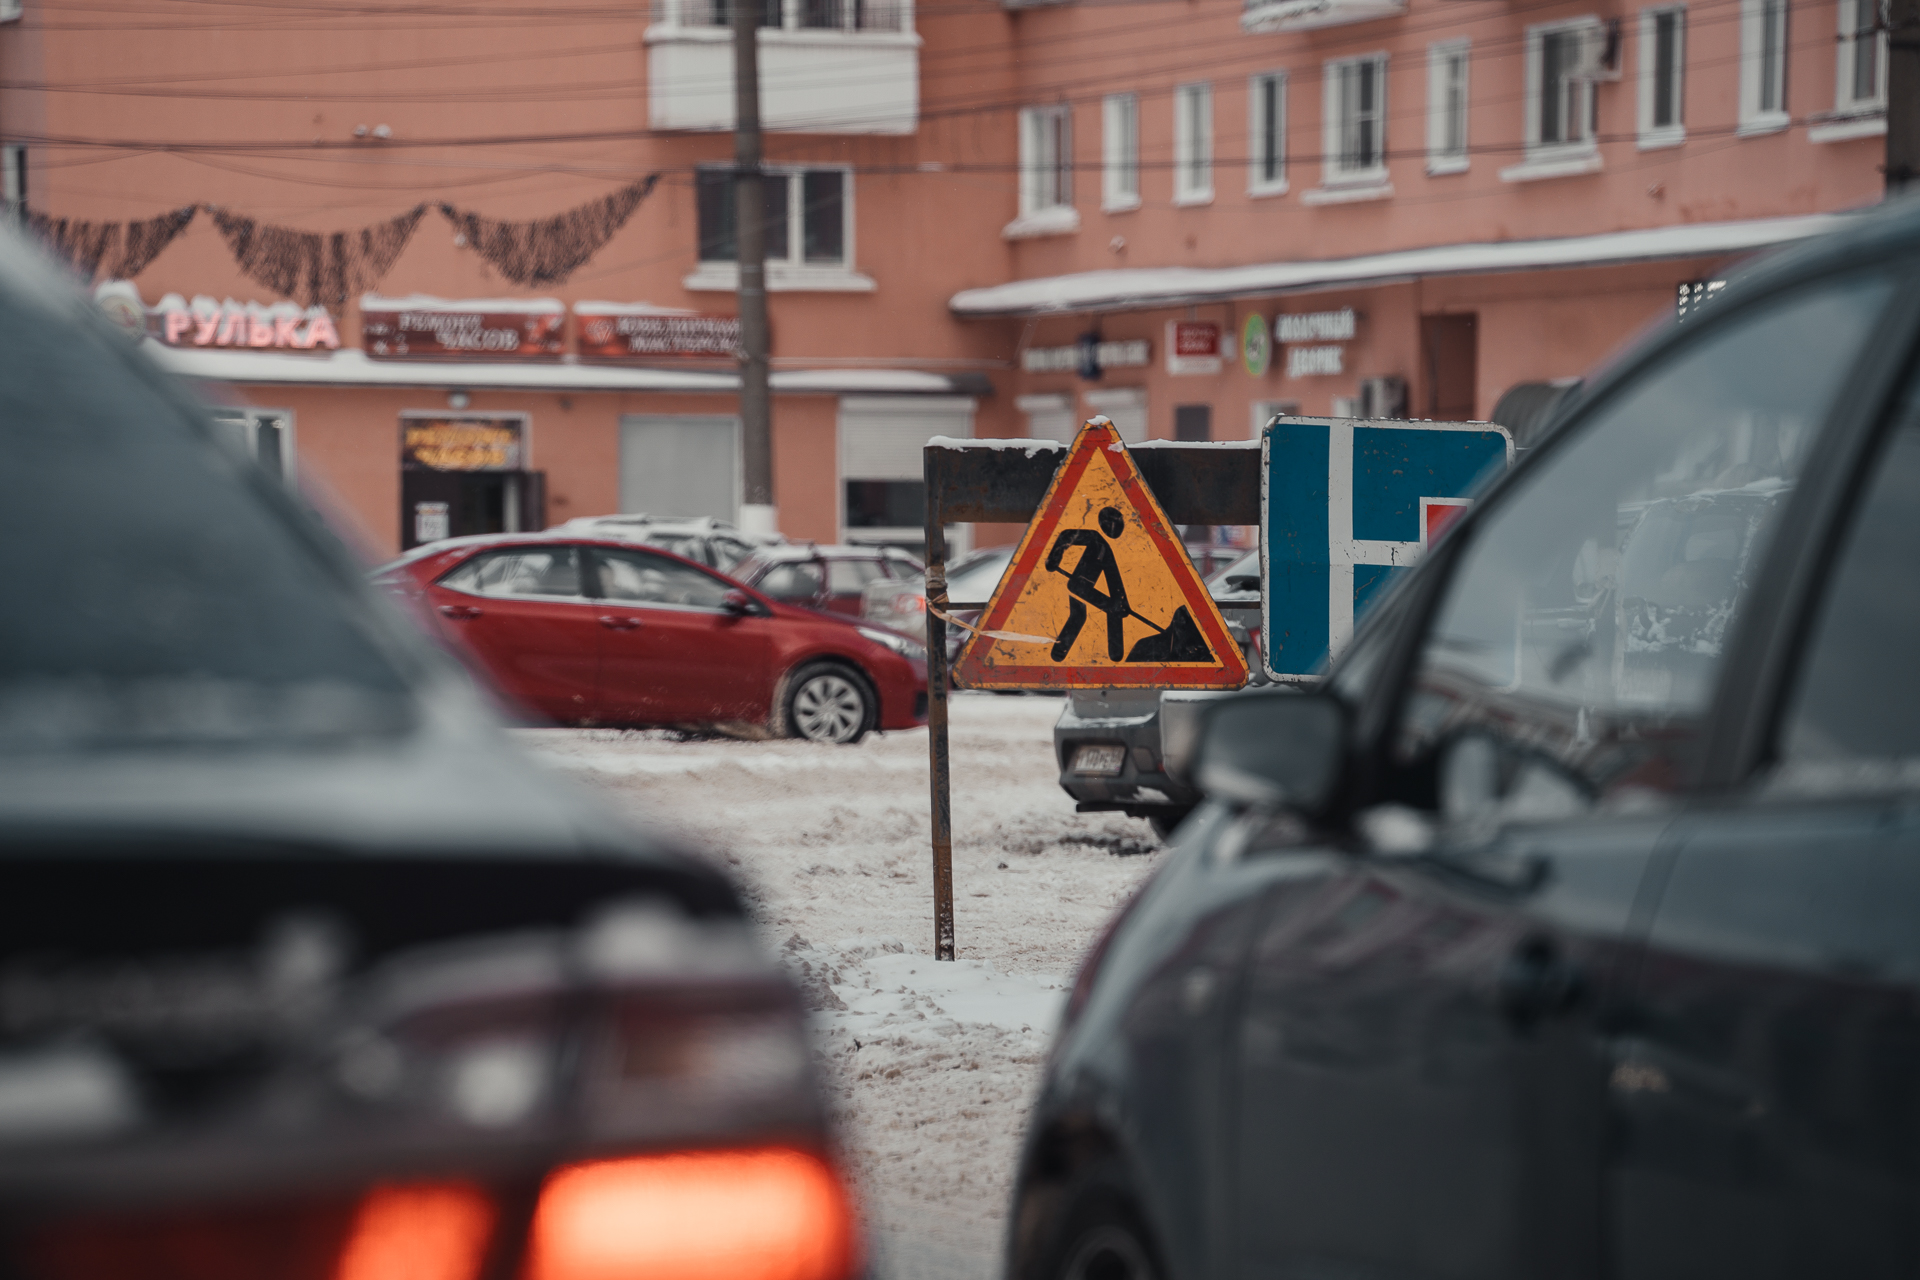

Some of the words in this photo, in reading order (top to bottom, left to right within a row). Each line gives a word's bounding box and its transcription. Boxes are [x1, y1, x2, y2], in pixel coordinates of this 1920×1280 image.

[163, 309, 340, 349] РУЛЬКА
[399, 313, 482, 331] РЕМОНТ
[435, 327, 519, 351] ЧАСОВ
